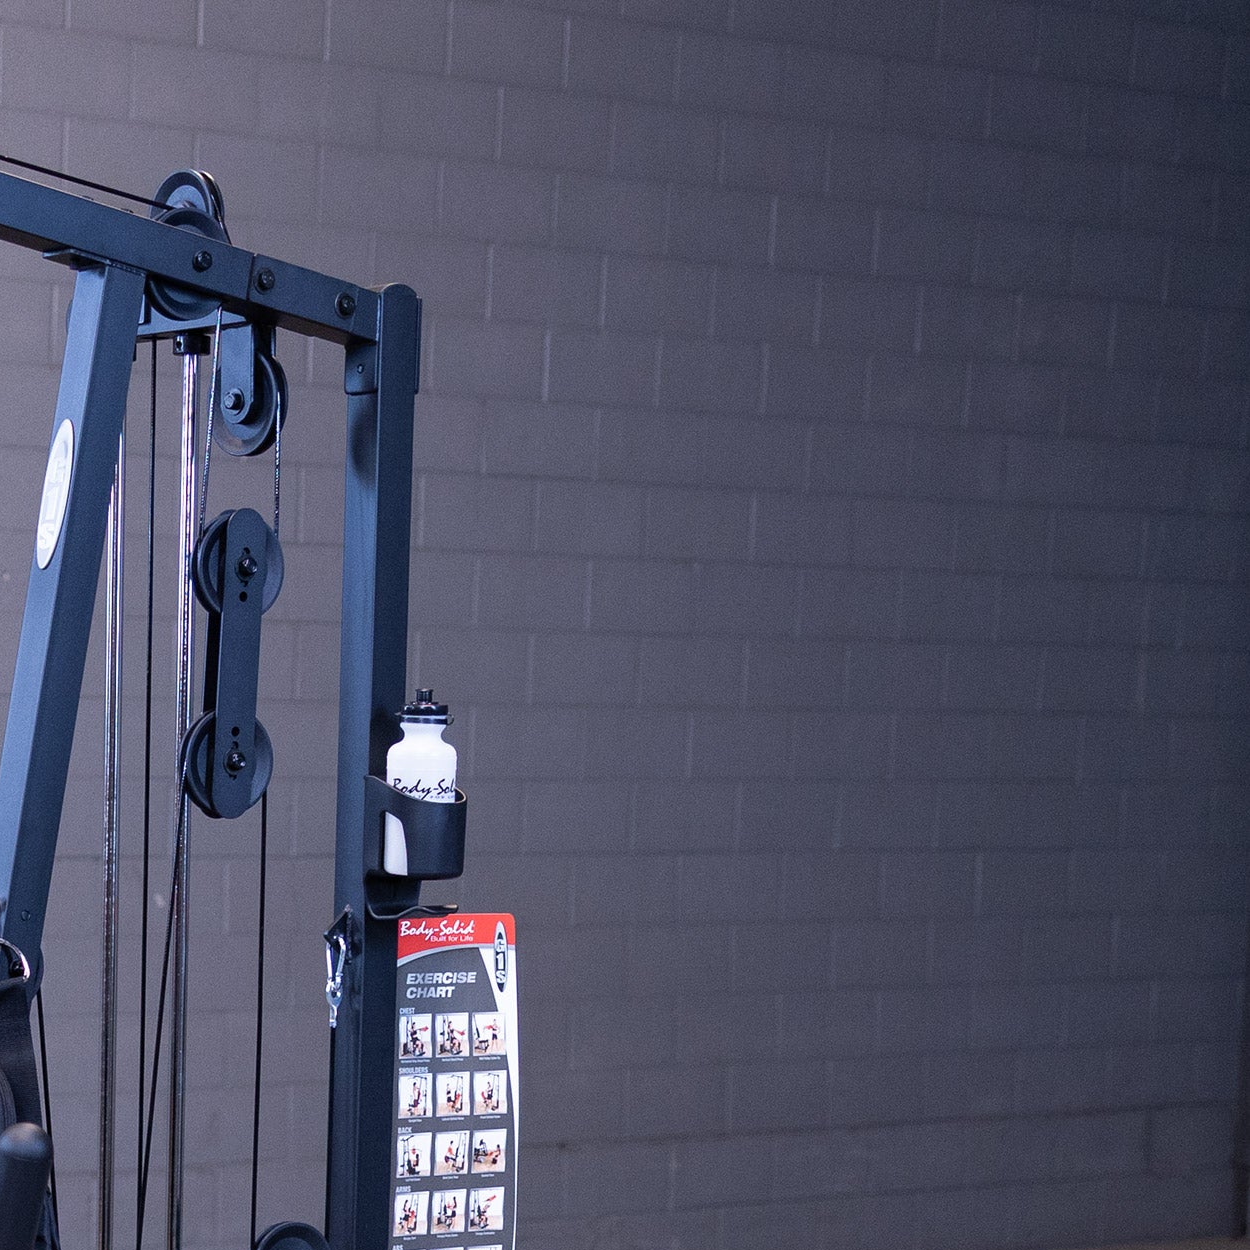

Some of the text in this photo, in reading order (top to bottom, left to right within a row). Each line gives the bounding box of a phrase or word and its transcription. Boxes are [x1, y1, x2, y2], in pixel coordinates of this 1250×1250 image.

[393, 778, 454, 800] Body-Sol
[400, 920, 475, 940] Body-Solid
[406, 972, 477, 984] EXERCISE
[406, 986, 455, 999] CHART
